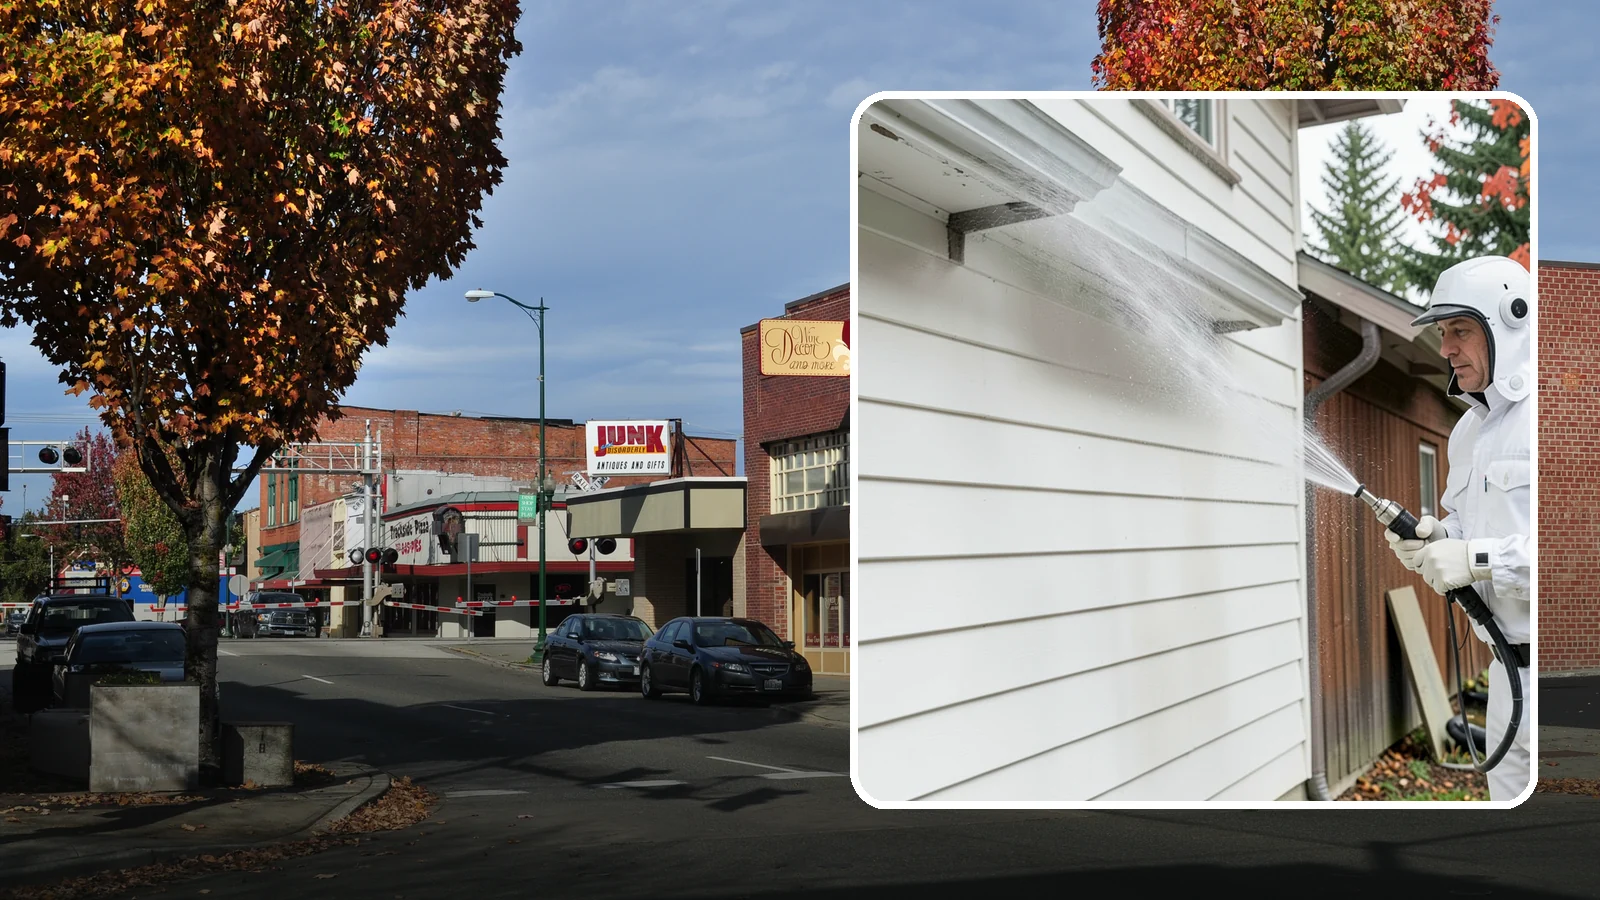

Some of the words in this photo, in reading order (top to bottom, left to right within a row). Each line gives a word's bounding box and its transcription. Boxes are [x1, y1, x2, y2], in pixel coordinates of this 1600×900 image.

[595, 425, 665, 457] JUNK
[607, 445, 646, 454] DISORDERLY
[597, 461, 628, 470] ANTIQUES
[631, 461, 644, 469] AND
[647, 460, 665, 469] GIFTS
[415, 519, 429, 535] Pizza
